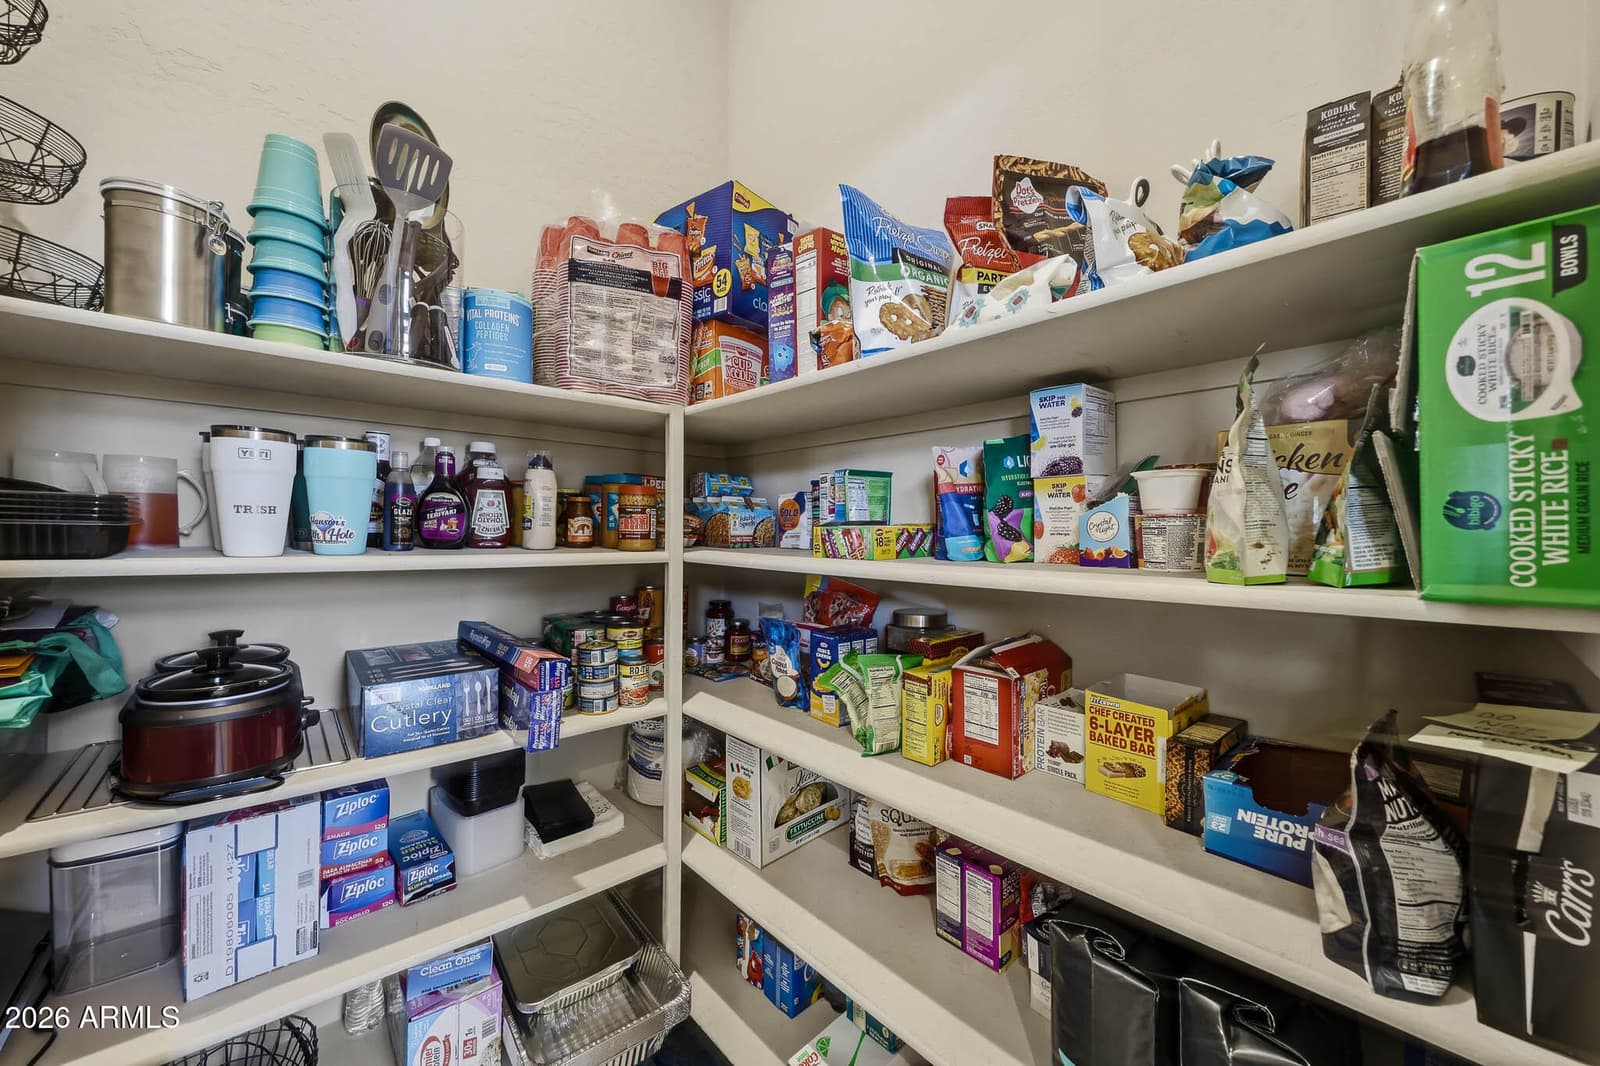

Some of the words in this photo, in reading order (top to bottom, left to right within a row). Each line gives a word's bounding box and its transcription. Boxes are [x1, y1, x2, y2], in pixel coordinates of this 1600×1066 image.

[1321, 101, 1358, 121] KODIAK
[1349, 160, 1366, 170] 220
[1016, 183, 1035, 196] Dot's
[905, 255, 943, 273] ORIGINAL
[1464, 240, 1547, 299] 12
[1559, 233, 1579, 278] BOWLS
[716, 271, 728, 288] 54
[901, 264, 950, 287] ORGANIC
[977, 271, 1007, 282] PART
[474, 320, 510, 333] COLLAGEN
[484, 308, 520, 327] PROTEINS
[475, 330, 509, 341] PEPTIDES
[1477, 323, 1488, 360] STICKY
[1487, 333, 1498, 355] RICE
[731, 355, 753, 370] CUP
[726, 364, 758, 385] NOODLES
[1477, 362, 1488, 405] COOKED
[1488, 357, 1498, 393] WHITE
[1038, 394, 1056, 403] SKIP
[1039, 400, 1066, 409] WATER
[1275, 442, 1343, 474] cken
[1508, 433, 1537, 503] STICKY
[1540, 450, 1569, 495] RICE
[1576, 461, 1590, 486] RICE
[1468, 494, 1485, 527] bibigo
[1576, 487, 1590, 514] GRAIN
[426, 508, 457, 520] TERIYAKI
[1088, 517, 1113, 531] Crystal
[327, 527, 356, 541] Hole
[1095, 524, 1115, 536] Light
[1541, 499, 1570, 567] WHITE
[1576, 516, 1591, 555] MEDIUM
[875, 536, 884, 548] 18
[1508, 507, 1537, 588] COOKED
[386, 700, 423, 713] Crystal
[426, 695, 453, 706] Clear
[370, 708, 452, 733] Cutlery
[1037, 707, 1046, 729] BAR
[1088, 704, 1111, 719] CHEF
[1112, 709, 1155, 728] CREATED
[1088, 715, 1155, 745] 6-LAYER
[1036, 728, 1046, 770] PROTEIN
[1088, 730, 1128, 750] BAKED
[1129, 741, 1156, 757] BAR
[1064, 770, 1078, 780] PACK
[335, 793, 378, 820] Ziploc
[326, 831, 351, 841] SNACK
[374, 822, 387, 831] 120
[788, 809, 825, 836] FETTUCCINE
[1210, 821, 1226, 832] 23
[1237, 808, 1315, 841] PROTEIN
[335, 835, 379, 857] Ziploc
[401, 839, 440, 855] SLIDER
[1253, 825, 1307, 851] PURE
[1327, 832, 1345, 846] sea
[225, 843, 236, 881] 14:27
[402, 845, 441, 863] Ziploc
[322, 867, 339, 876] PARA
[339, 857, 373, 871] ALMACENAR
[374, 857, 385, 865] 50
[409, 863, 440, 883] Ziploc
[345, 877, 386, 899] Ziploc
[407, 880, 428, 892] SLIDER
[334, 908, 370, 927] BOCADILLO
[381, 898, 394, 908] 120
[420, 961, 453, 977] Clean
[455, 952, 481, 967] Ones
[424, 1047, 433, 1066] mier
[433, 1046, 441, 1066] otein
